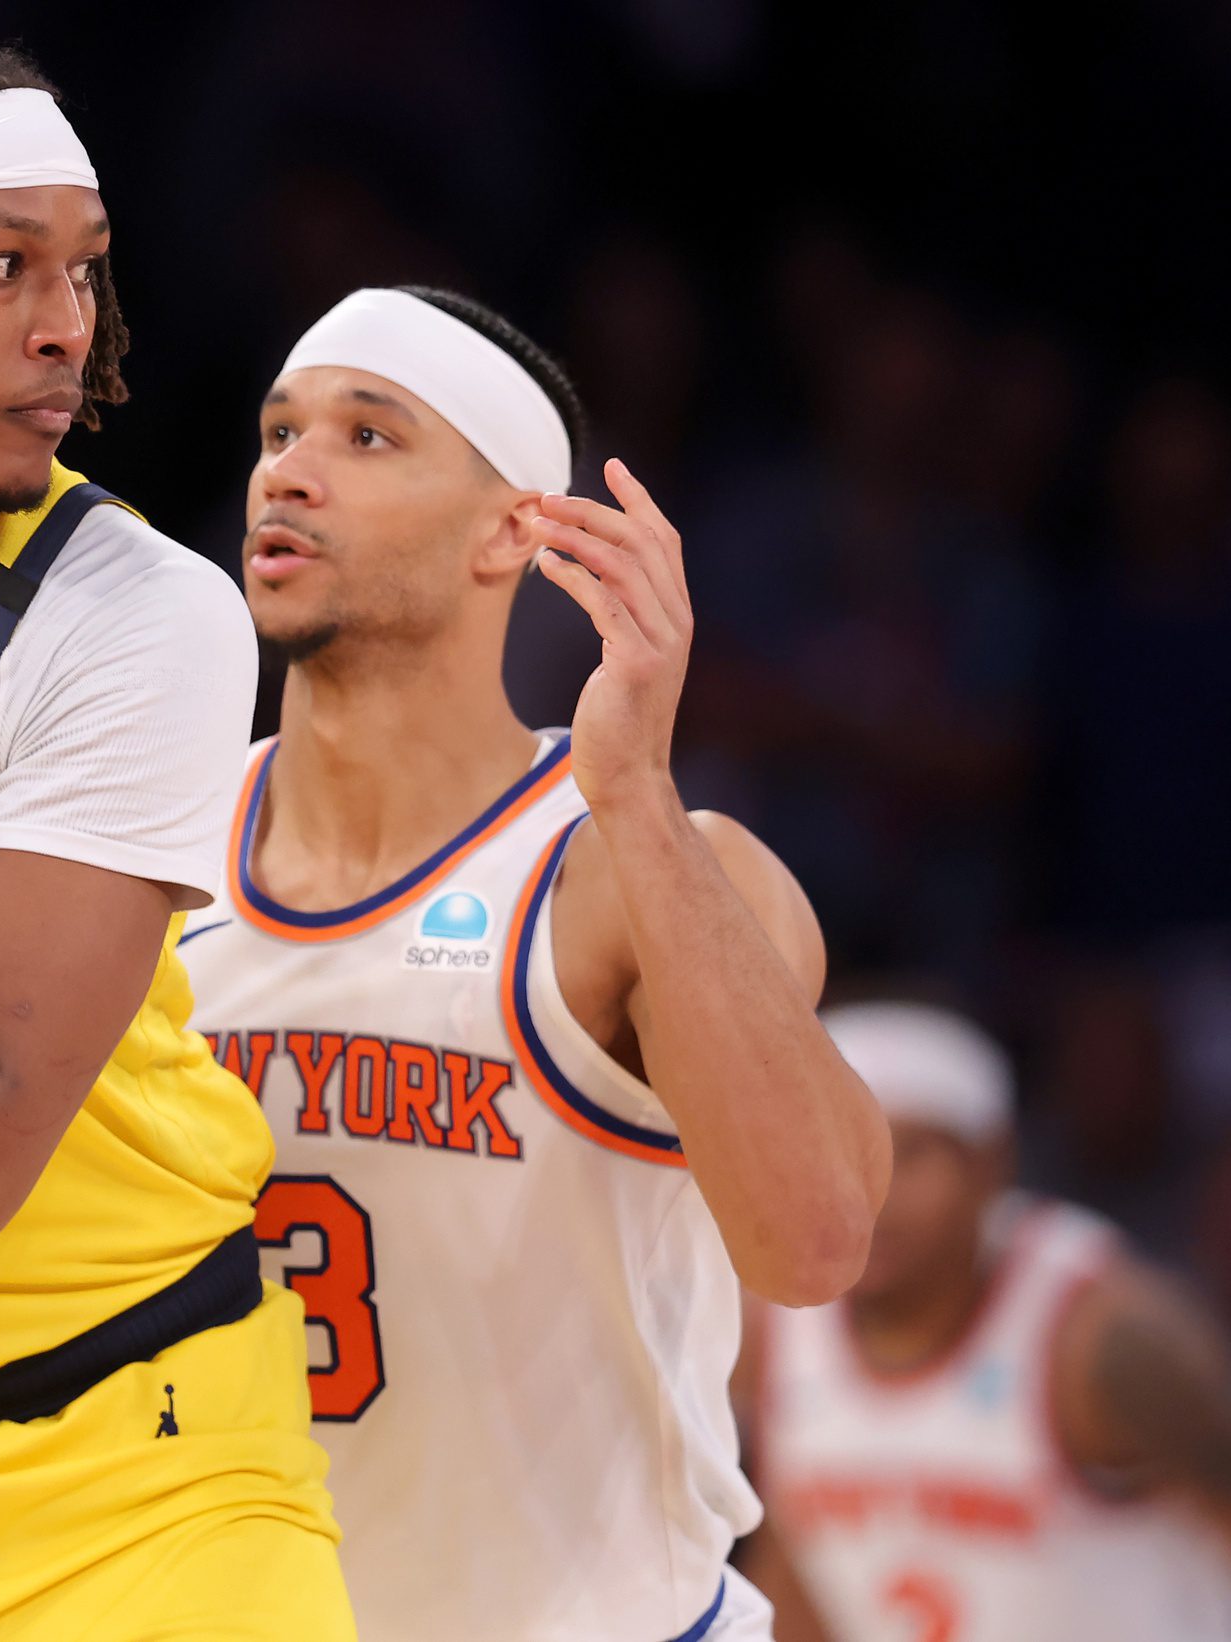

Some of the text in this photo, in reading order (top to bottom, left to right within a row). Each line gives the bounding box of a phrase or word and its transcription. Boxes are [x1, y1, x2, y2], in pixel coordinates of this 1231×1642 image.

[405, 944, 490, 970] sphere
[284, 1029, 525, 1162] YORK
[251, 1174, 386, 1423] 3
